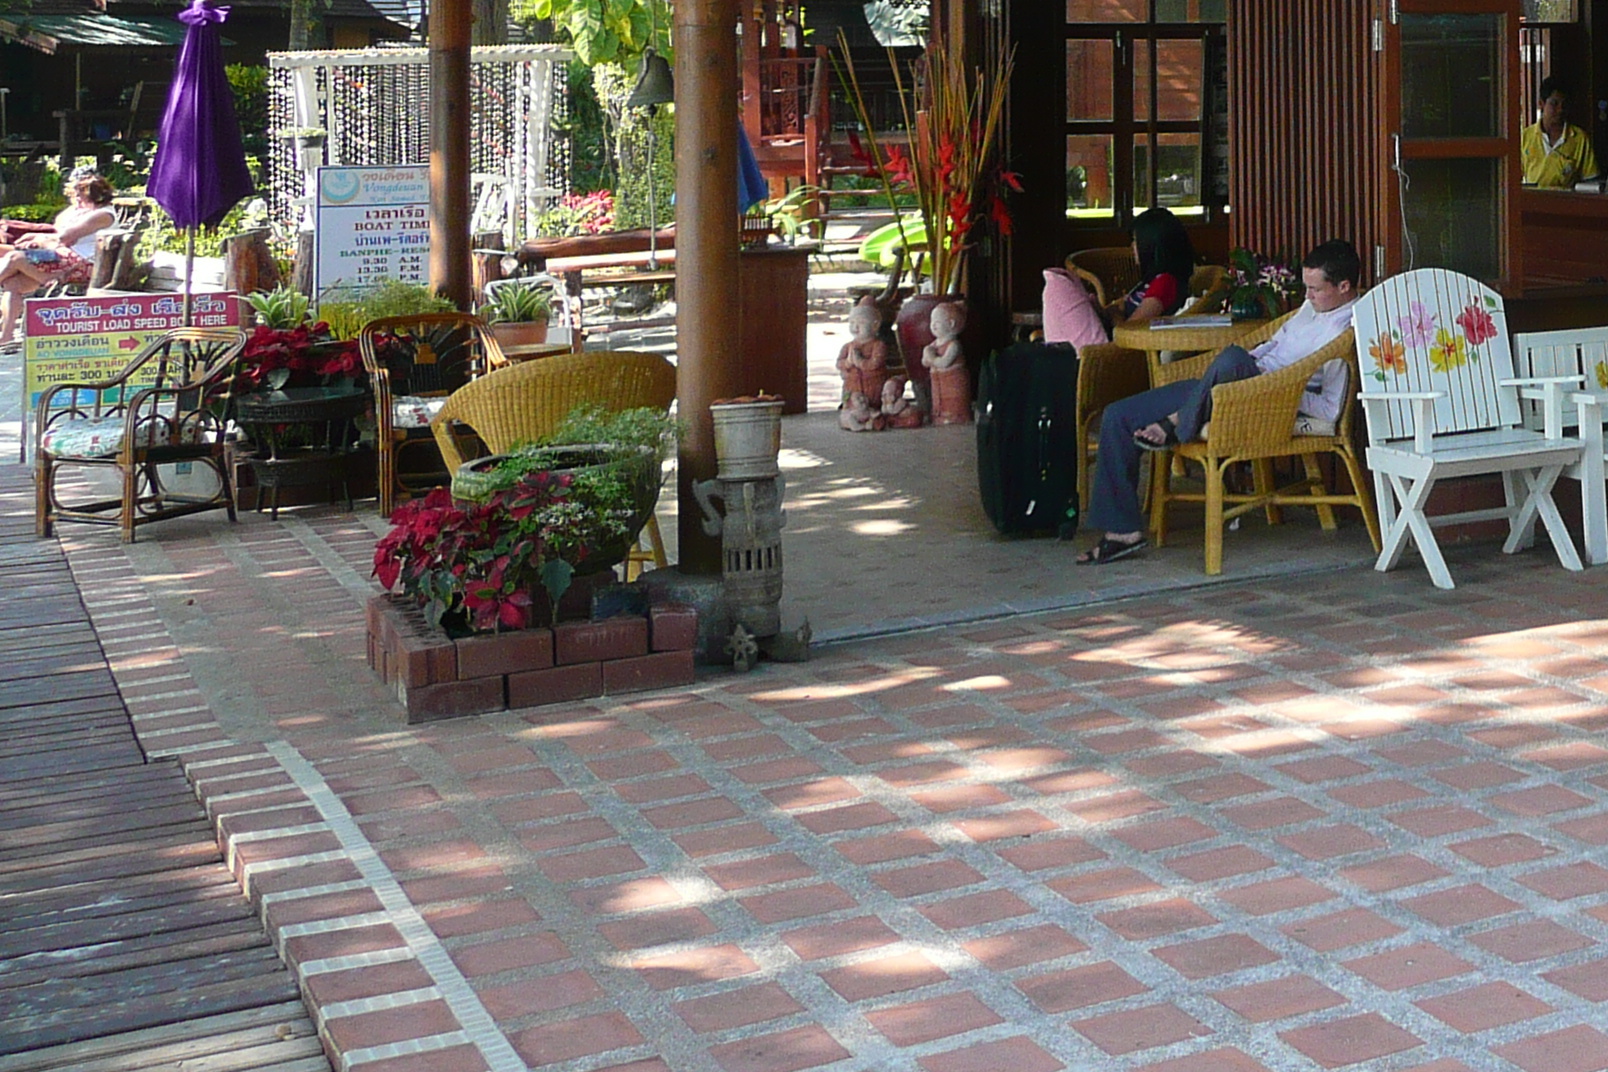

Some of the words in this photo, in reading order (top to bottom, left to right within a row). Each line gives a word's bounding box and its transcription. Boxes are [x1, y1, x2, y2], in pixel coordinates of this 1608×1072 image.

[365, 205, 424, 219] เวลาเรือ
[354, 222, 393, 231] BOAT
[400, 220, 430, 230] TIM
[340, 247, 430, 257] BANPHE-RES
[56, 321, 100, 333] TOURIST
[103, 319, 131, 331] LOAD
[134, 317, 167, 329] SPEED
[170, 316, 197, 327] BOT
[200, 314, 227, 325] HERE
[80, 370, 102, 380] 300
